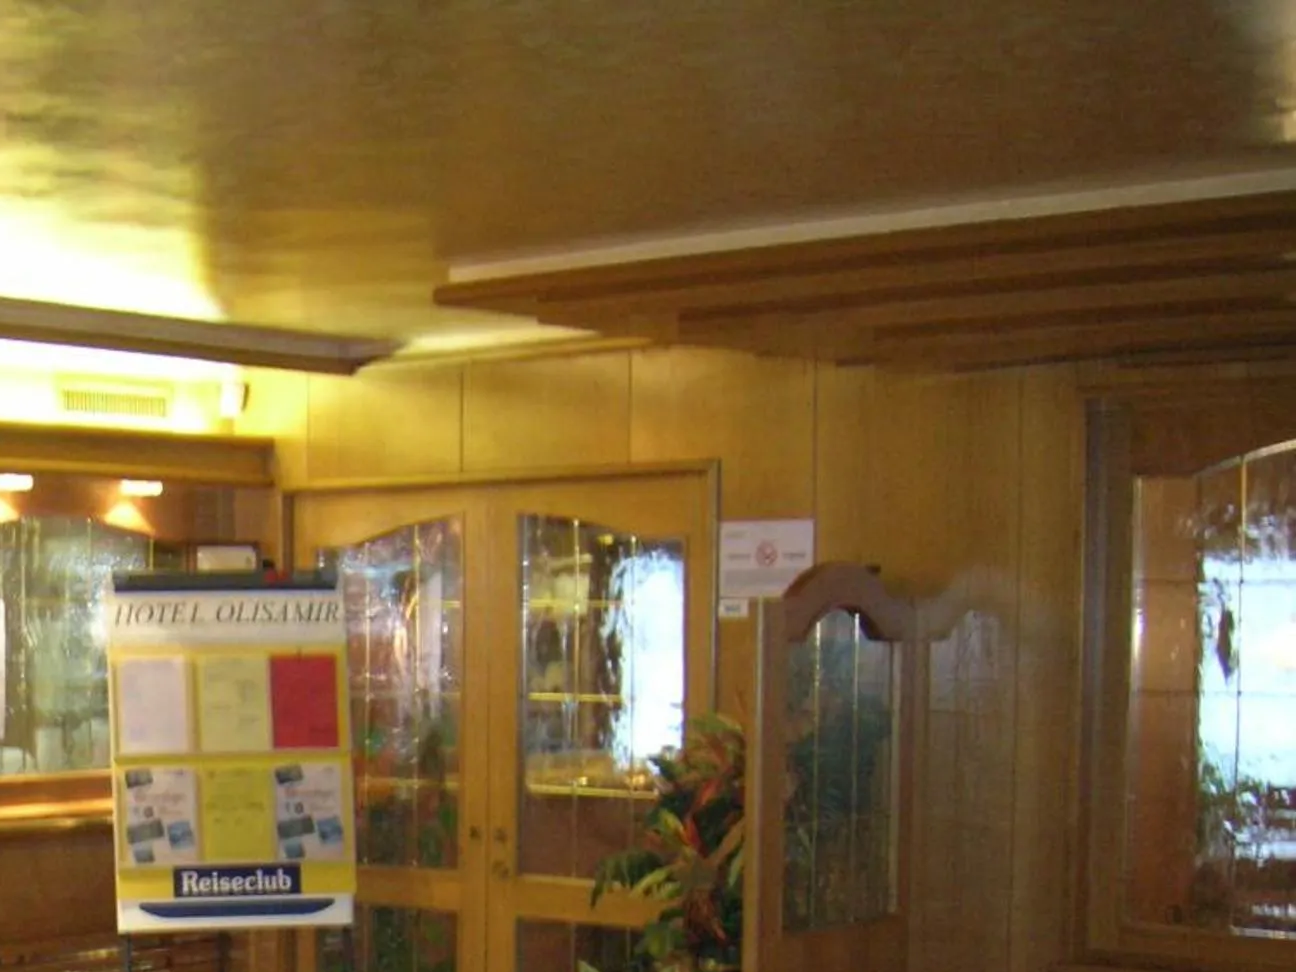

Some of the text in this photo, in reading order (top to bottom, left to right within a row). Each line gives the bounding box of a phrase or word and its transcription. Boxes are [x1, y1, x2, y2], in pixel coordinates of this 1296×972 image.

[114, 599, 341, 627] HOTEL OLISAMIR
[181, 867, 293, 896] Reiseclub
